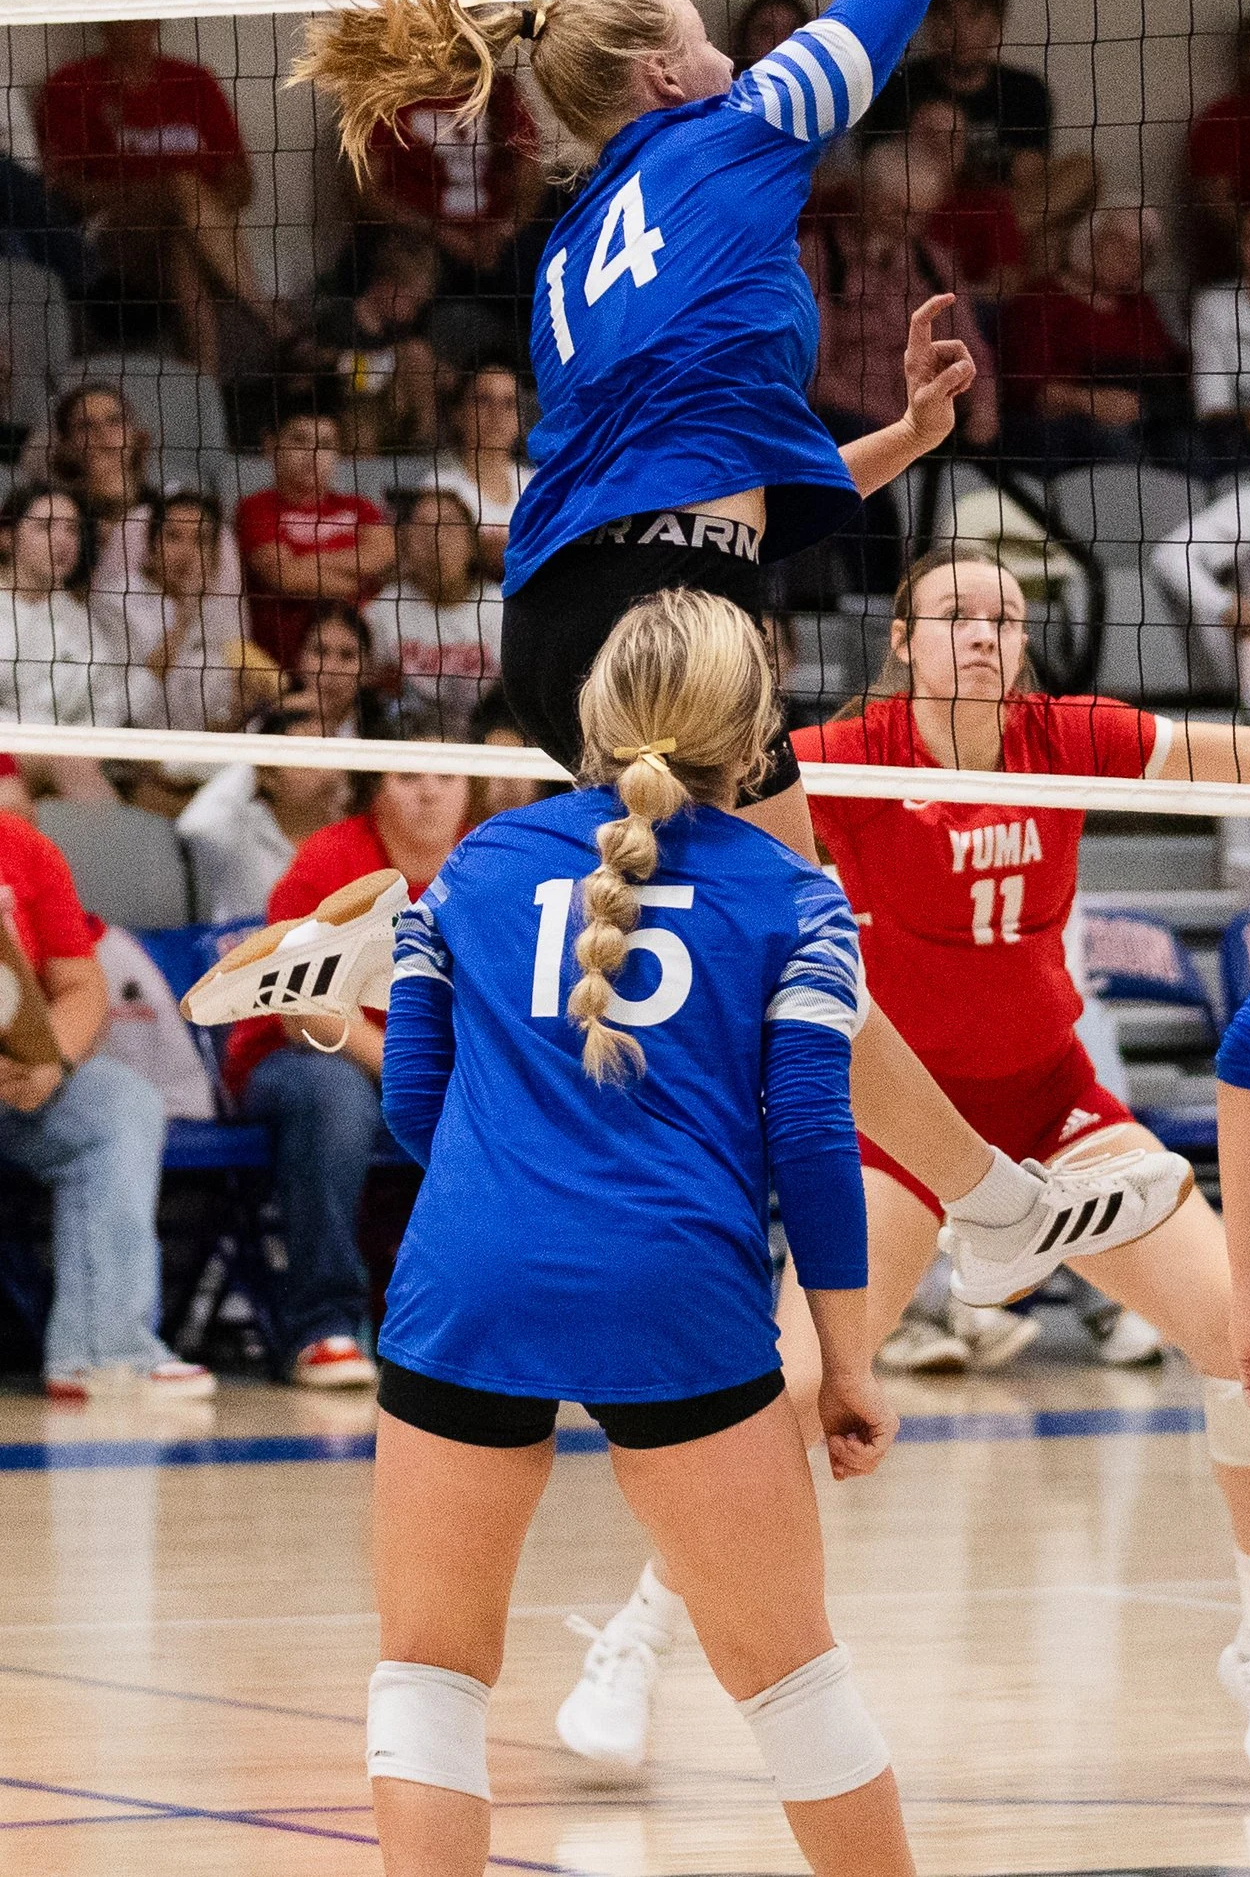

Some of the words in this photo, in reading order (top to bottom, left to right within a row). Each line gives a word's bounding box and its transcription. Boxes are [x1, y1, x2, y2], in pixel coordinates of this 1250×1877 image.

[546, 170, 665, 365] 14
[949, 817, 1043, 873] YUMA
[531, 879, 695, 1027] 15
[970, 874, 1025, 946] 11
